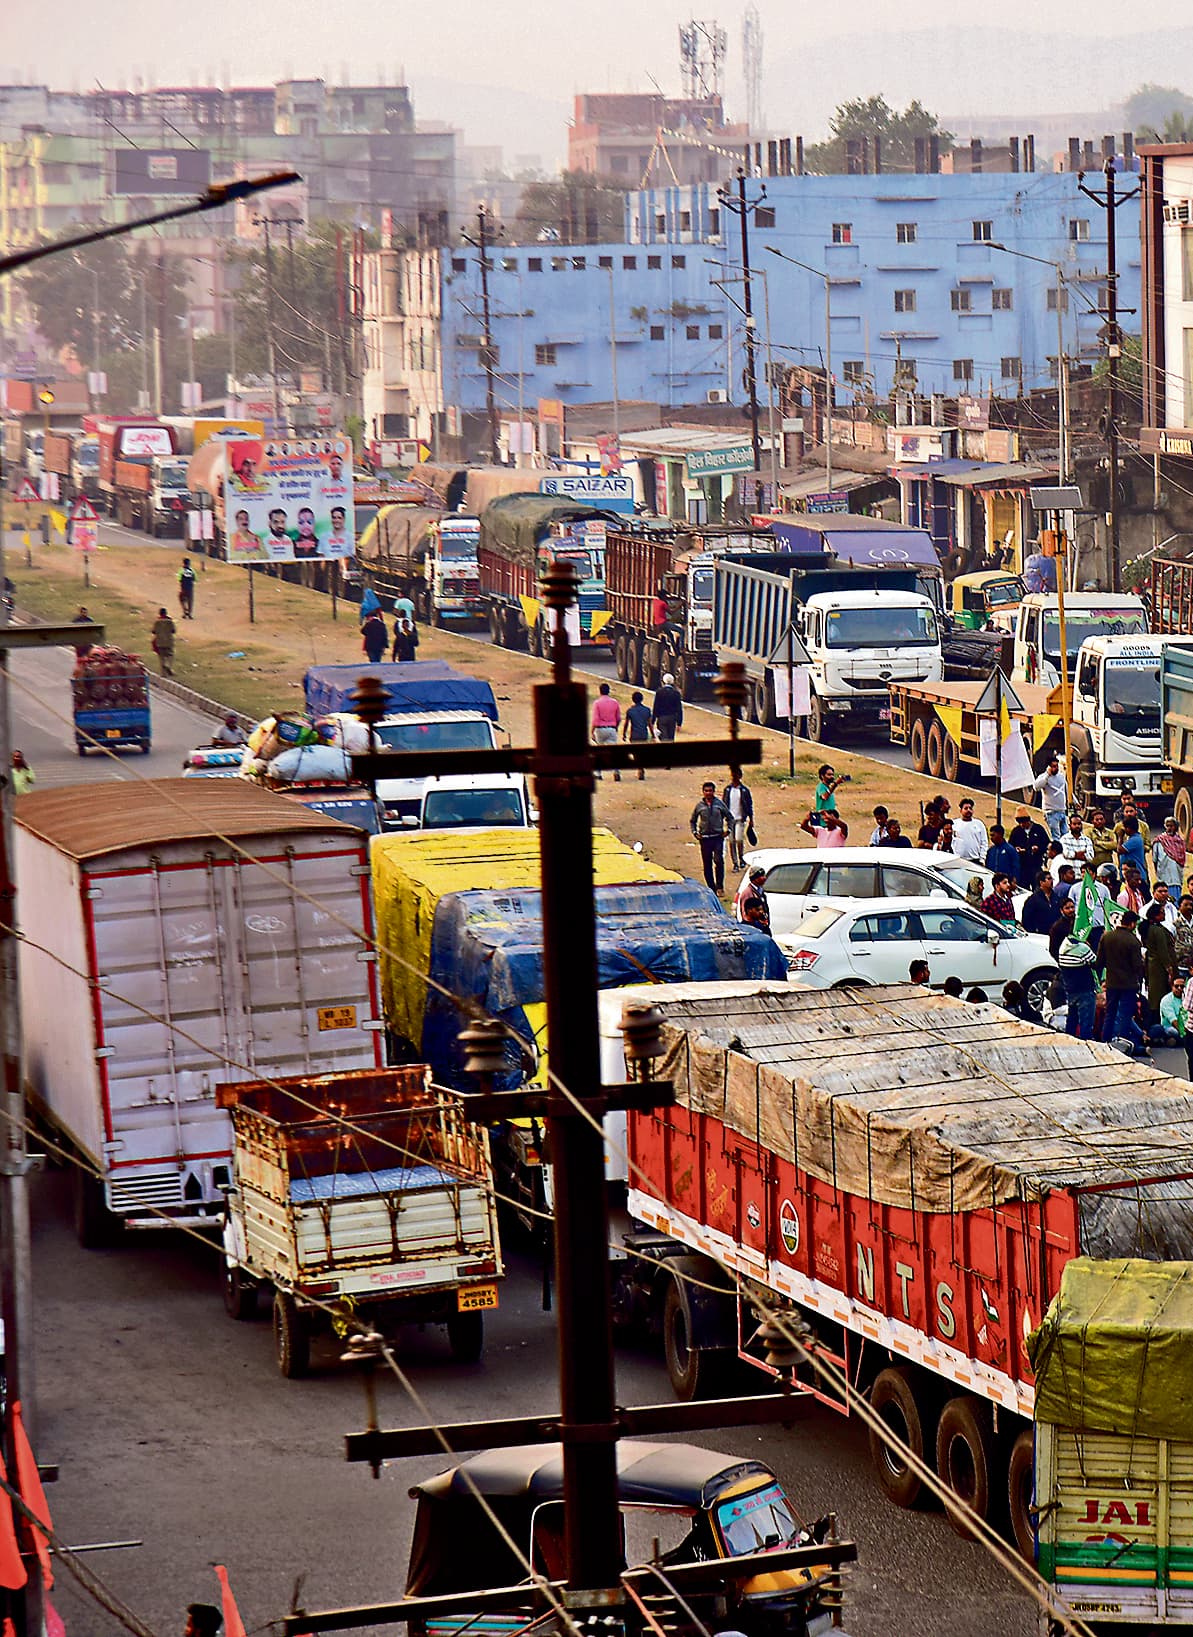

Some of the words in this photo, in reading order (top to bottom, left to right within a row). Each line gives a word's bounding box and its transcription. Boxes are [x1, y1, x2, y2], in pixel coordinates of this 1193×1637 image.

[563, 479, 627, 492] SAIZAR
[462, 1298, 494, 1308] 4585
[1077, 1499, 1152, 1526] JAI
